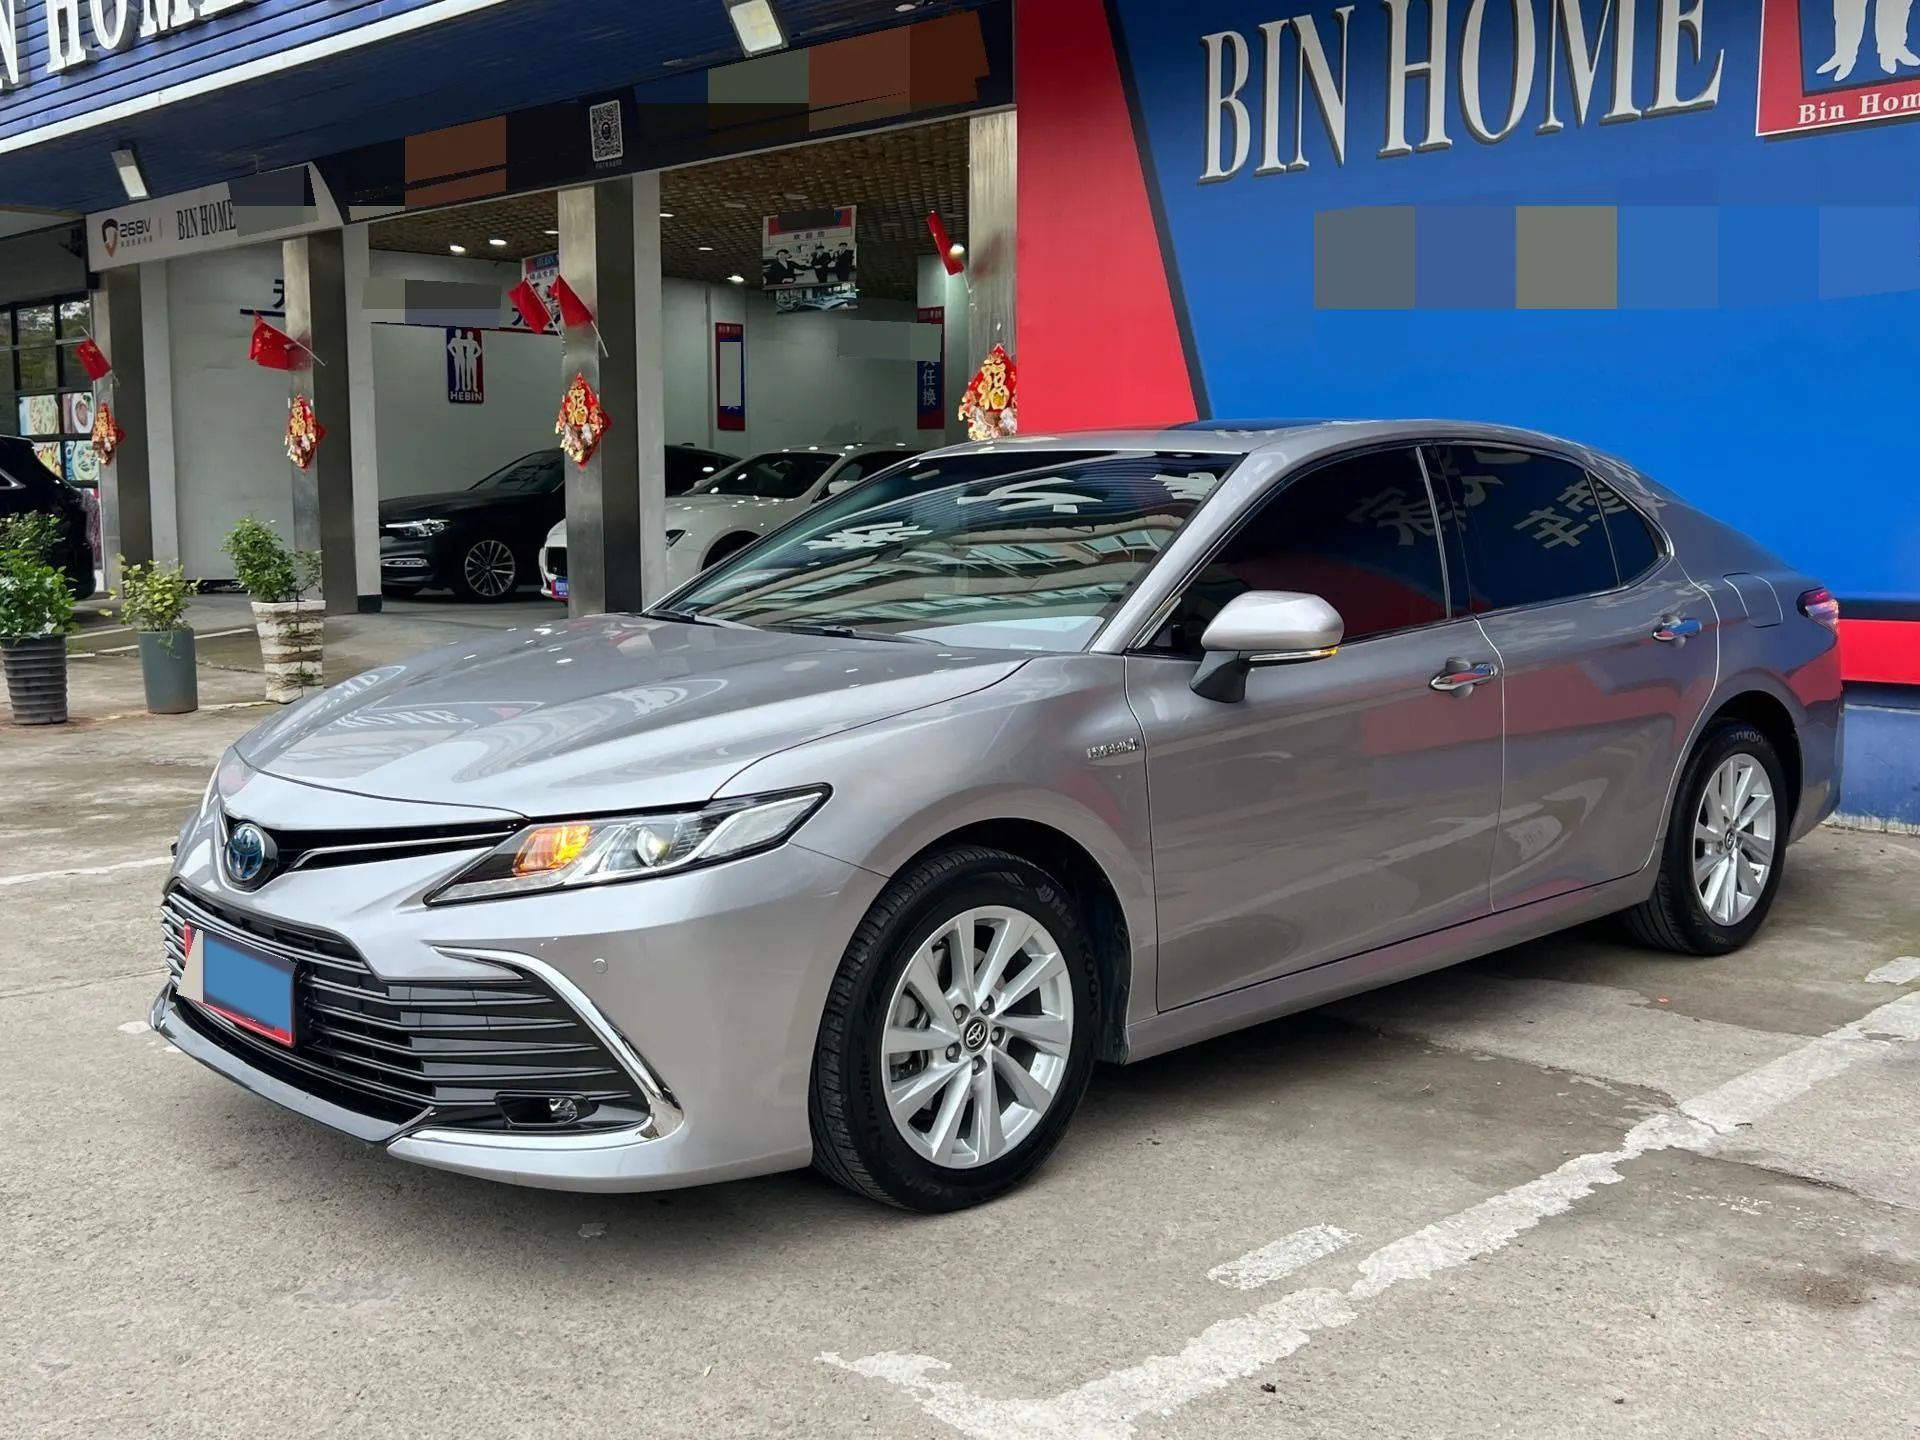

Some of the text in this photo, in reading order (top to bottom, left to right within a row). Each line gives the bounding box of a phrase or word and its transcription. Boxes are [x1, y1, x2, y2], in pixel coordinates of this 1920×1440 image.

[1197, 0, 1725, 185] BIN HOME
[1797, 102, 1845, 125] Bin
[120, 216, 151, 238] 268V
[176, 199, 236, 240] BIN HOME
[450, 391, 482, 401] HEBIN
